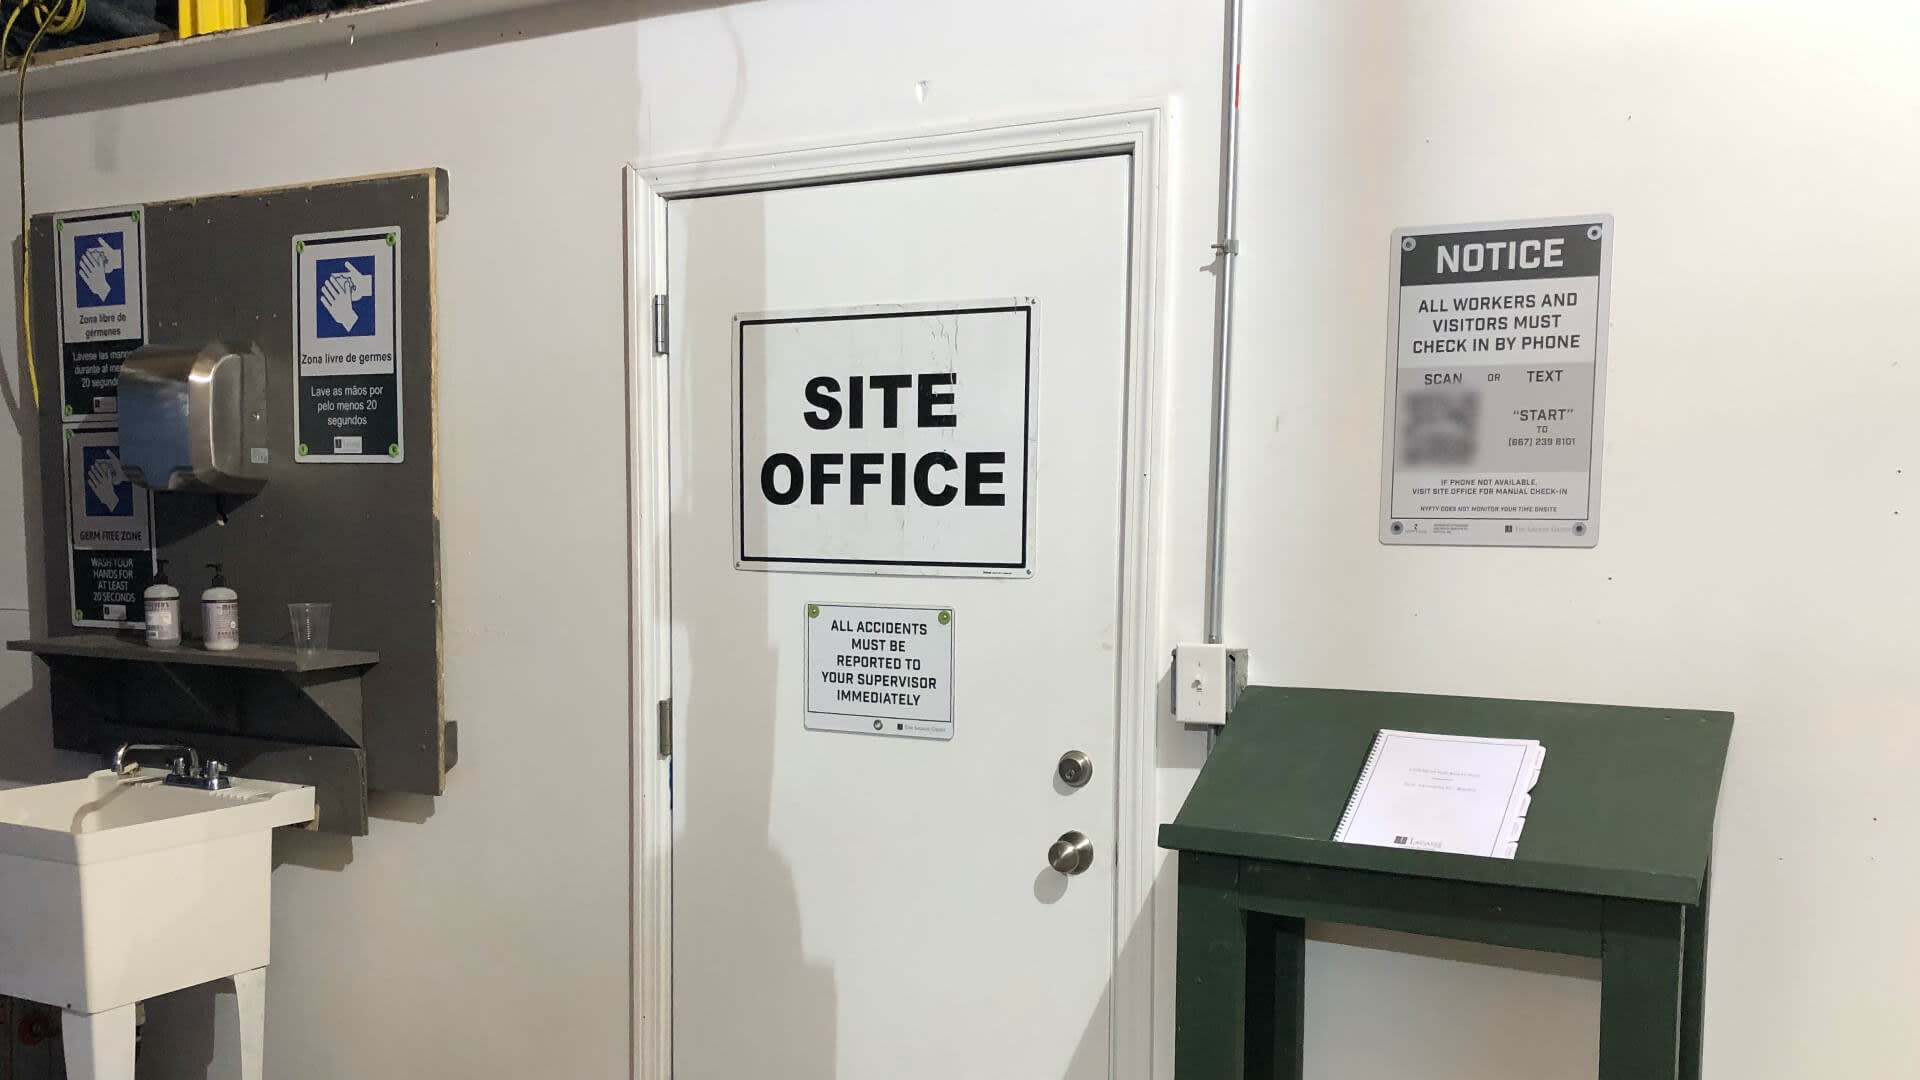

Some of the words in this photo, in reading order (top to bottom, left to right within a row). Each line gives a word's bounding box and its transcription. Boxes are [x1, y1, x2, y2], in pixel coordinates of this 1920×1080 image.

[1436, 238, 1564, 274] NOTICE
[1418, 300, 1448, 313] ALL
[1454, 294, 1536, 311] WORKERS
[1541, 292, 1578, 307] AND
[80, 314, 97, 324] Zona
[100, 314, 115, 322] libre
[117, 312, 126, 322] de
[1432, 317, 1508, 332] VISITORS
[1514, 314, 1562, 330] MUST
[1413, 339, 1466, 354] CHECK
[1473, 338, 1490, 351] IN
[1495, 337, 1517, 350] BY
[1522, 334, 1580, 350] PHONE
[99, 351, 108, 360] las
[302, 354, 322, 364] Zona
[326, 354, 344, 363] livre
[346, 353, 357, 362] de
[359, 353, 392, 364] germes
[74, 364, 100, 374] durante
[1424, 373, 1462, 385] SCAN
[1488, 373, 1500, 382] OR
[1527, 370, 1563, 382] TEXT
[311, 386, 330, 396] Lave
[333, 388, 342, 396] as
[345, 386, 367, 396] mãos
[370, 386, 384, 397] por
[318, 400, 334, 414] pelo
[337, 402, 364, 410] menos
[366, 400, 377, 410] 20
[804, 373, 956, 430] SITE
[1513, 408, 1574, 421] “START”
[328, 415, 368, 428] segundos
[760, 452, 1005, 506] OFFICE
[80, 531, 100, 540] GERM
[103, 531, 120, 540] FREE
[121, 531, 142, 541] ZONE
[91, 558, 112, 567] WASH
[114, 558, 133, 568] YOUR
[94, 570, 118, 579] HANDS
[120, 570, 133, 579] FOR
[98, 581, 107, 590] AT
[108, 581, 128, 590] LEAST
[94, 592, 102, 601] 20
[103, 592, 136, 602] SECONDS
[831, 620, 854, 632] ALL
[857, 621, 928, 635] ACCIDENTS
[852, 639, 886, 651] MUST
[890, 640, 906, 652] BE
[837, 655, 901, 670] REPORTED
[905, 659, 920, 670] TO
[822, 672, 854, 684] YOUR
[858, 674, 936, 689] SUPERVISOR
[837, 690, 920, 706] IMMEDIATELY
